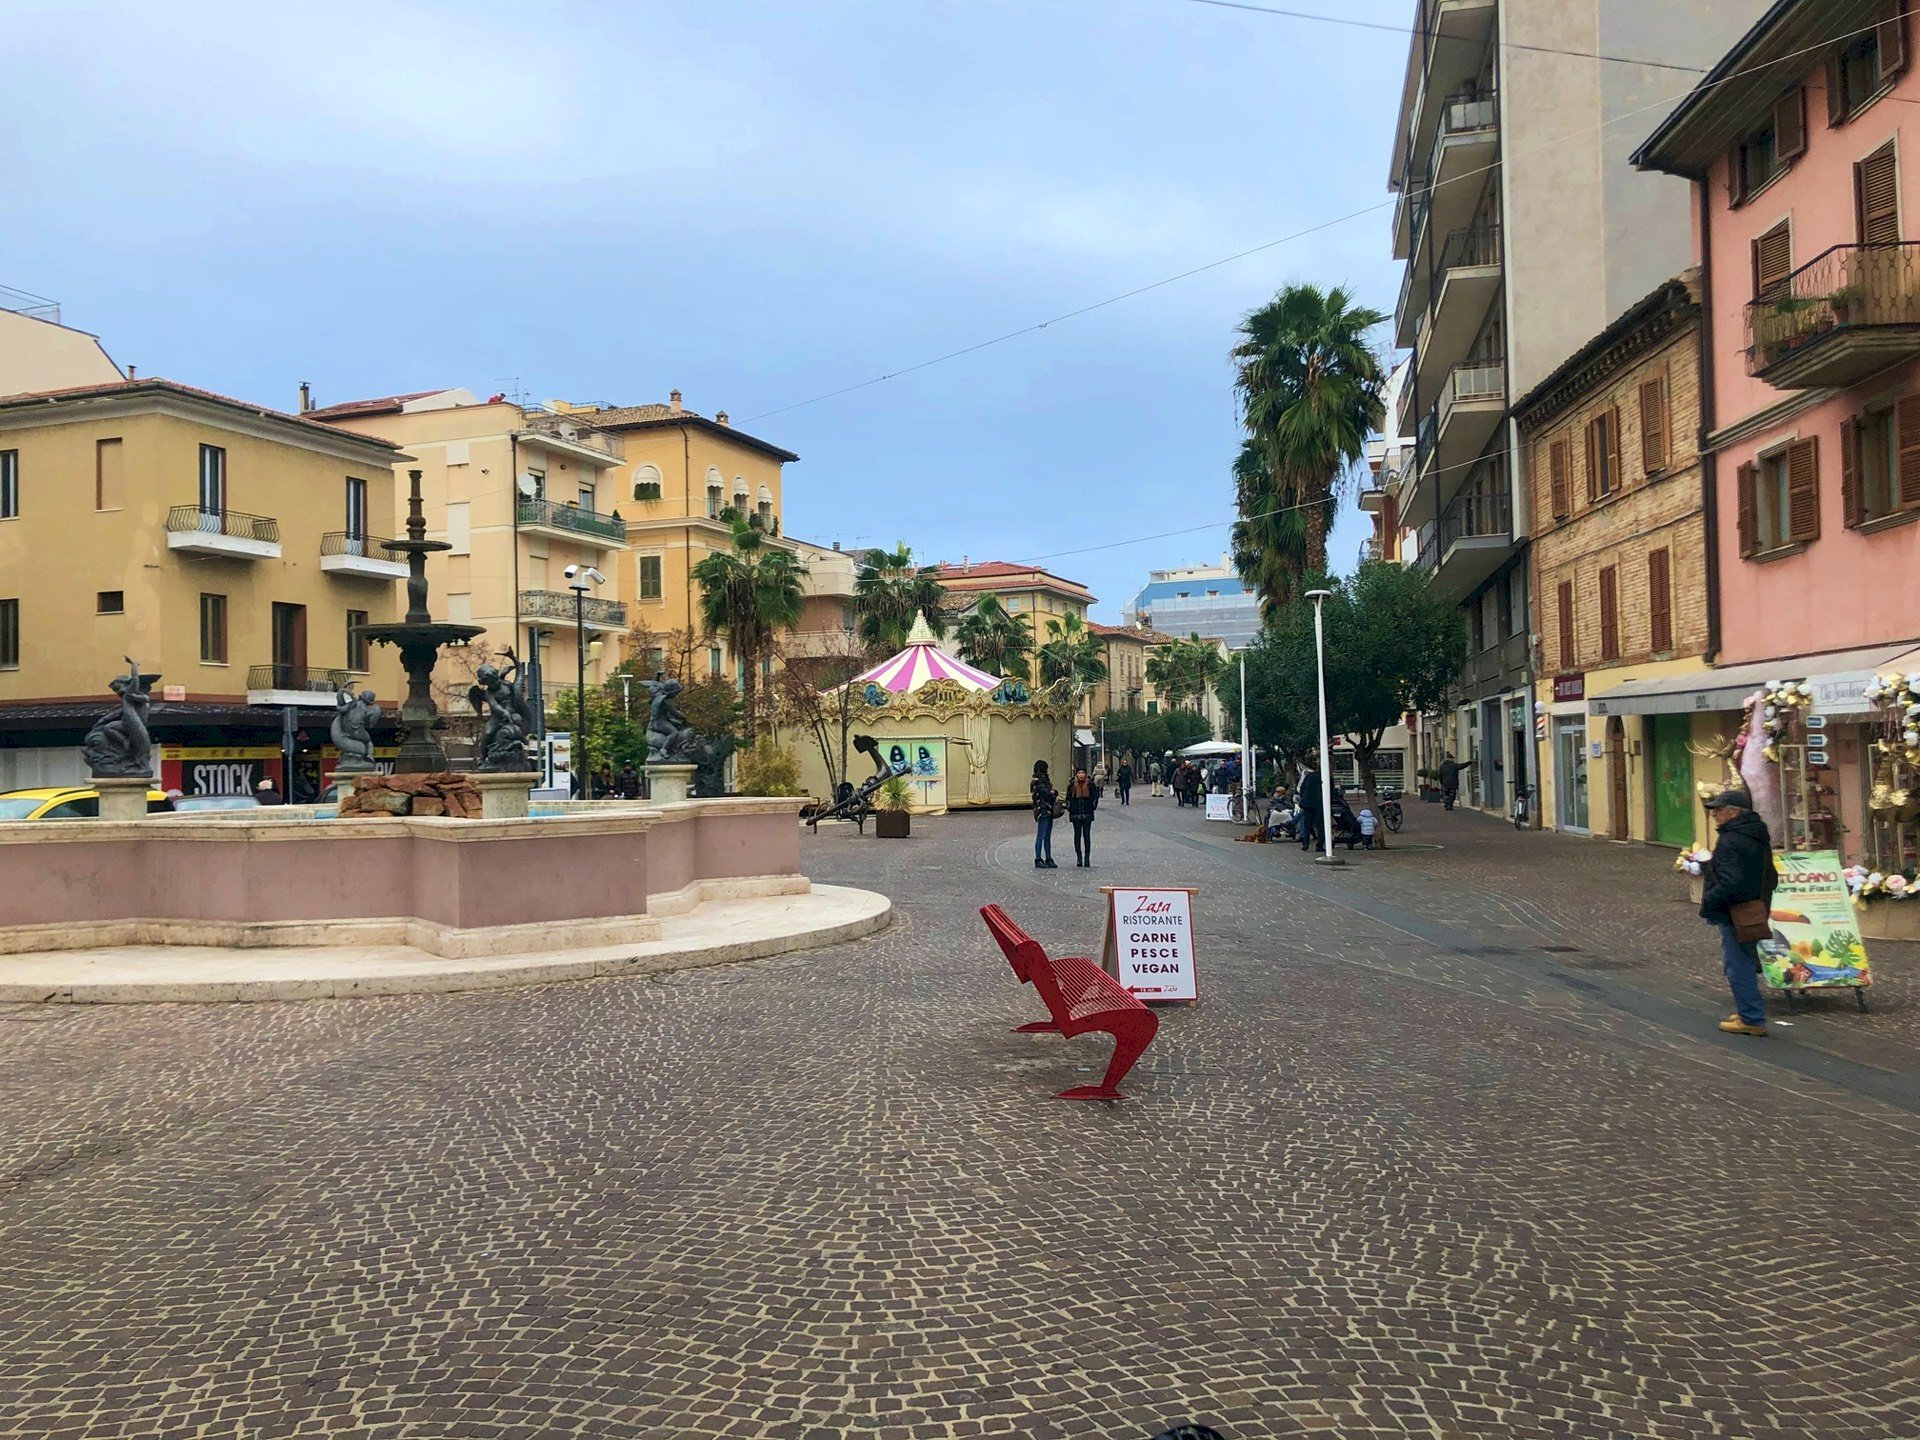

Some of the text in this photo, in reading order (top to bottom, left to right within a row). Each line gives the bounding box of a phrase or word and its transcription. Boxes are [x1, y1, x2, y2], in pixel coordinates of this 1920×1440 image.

[193, 763, 253, 796] STOCK
[1777, 871, 1838, 883] TUCANO
[1123, 915, 1183, 925] RISTORANTE
[1130, 933, 1176, 942] CARNE
[1131, 948, 1178, 957] PESCE
[1132, 964, 1179, 973] VEGAN
